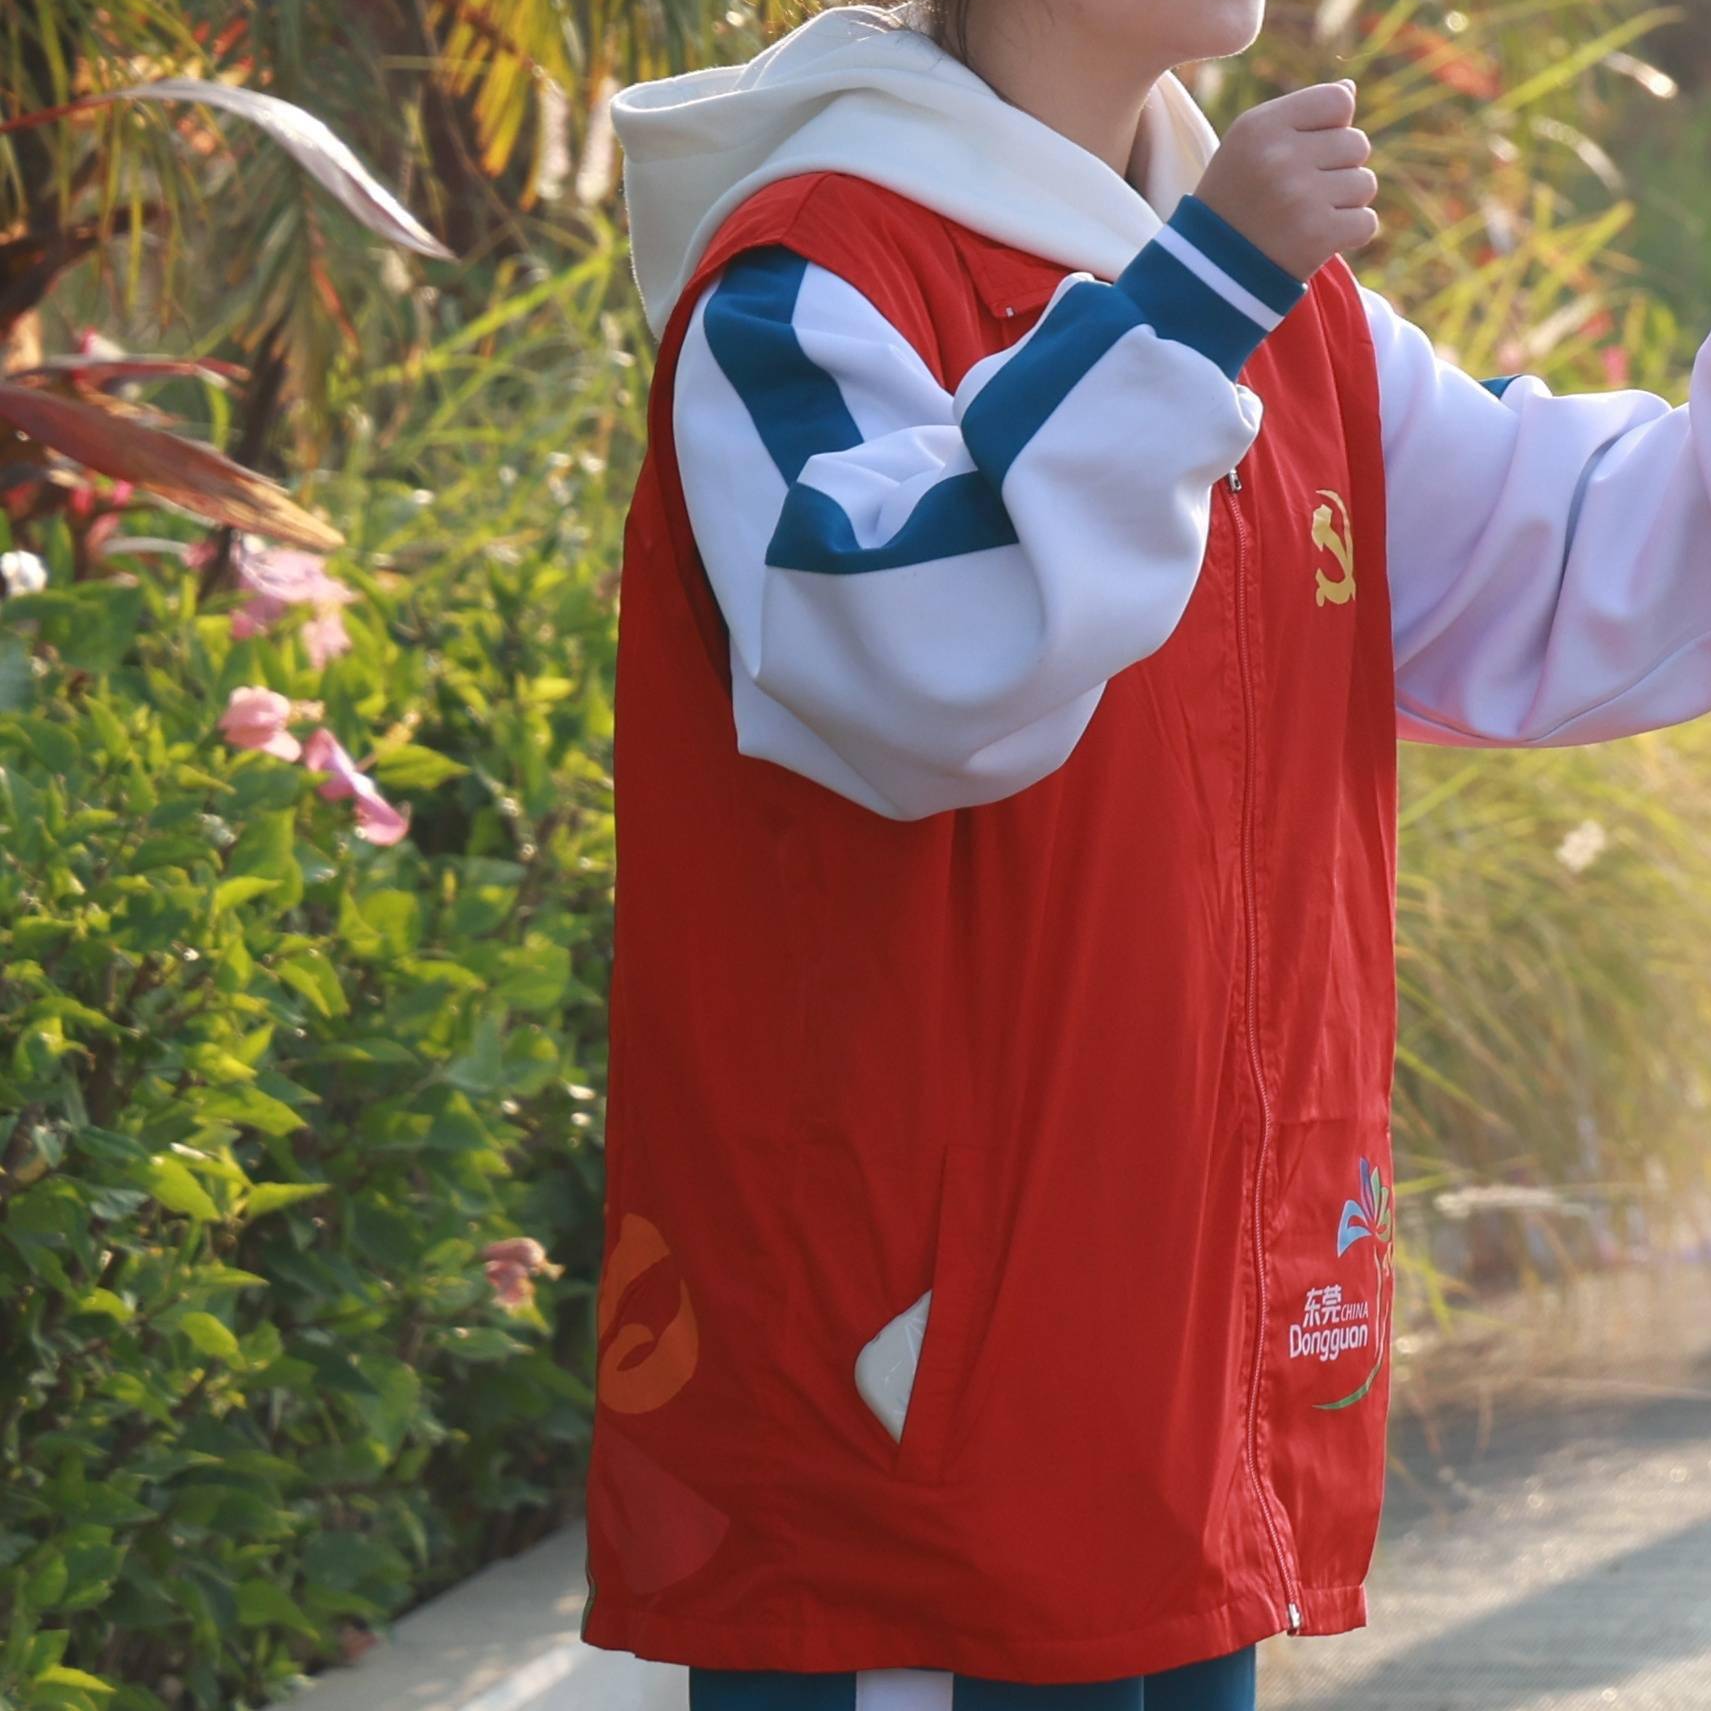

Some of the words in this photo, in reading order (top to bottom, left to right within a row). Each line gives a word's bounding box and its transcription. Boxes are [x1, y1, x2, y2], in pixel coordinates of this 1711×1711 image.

[1303, 1284, 1342, 1327] 东莞
[1341, 1301, 1369, 1321] CHINA
[1289, 1324, 1368, 1362] Dongguan
